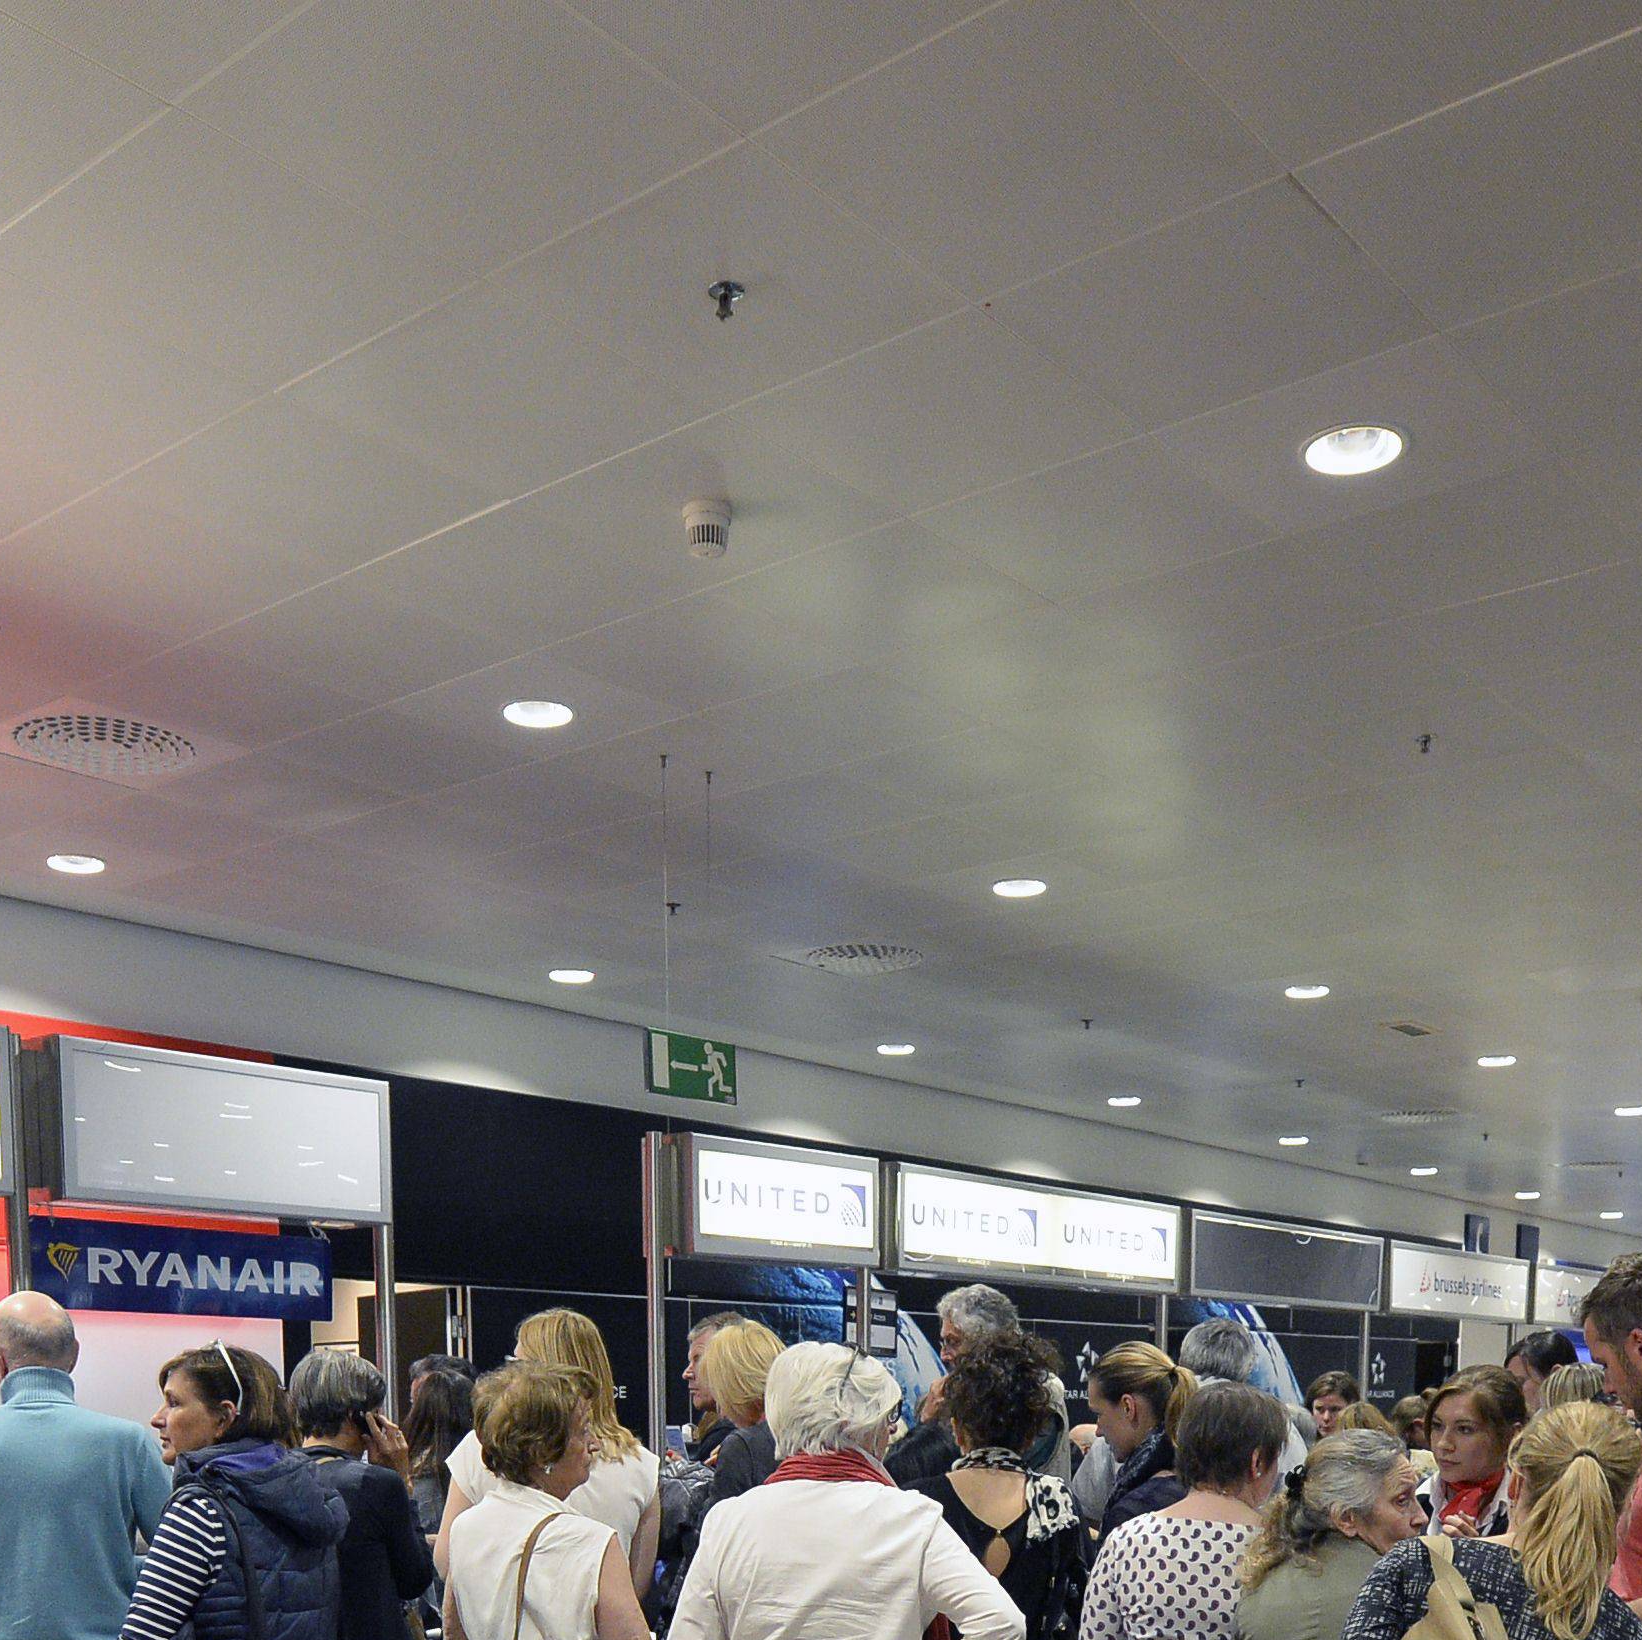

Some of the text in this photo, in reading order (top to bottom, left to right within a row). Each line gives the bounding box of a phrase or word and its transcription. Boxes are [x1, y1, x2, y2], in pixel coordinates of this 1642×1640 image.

[704, 1178, 830, 1214] UNITED
[911, 1202, 1009, 1236] UNITED
[1063, 1223, 1144, 1252] UNITED
[87, 1246, 321, 1297] RYANAIR
[1433, 1271, 1502, 1299] brussels airlines
